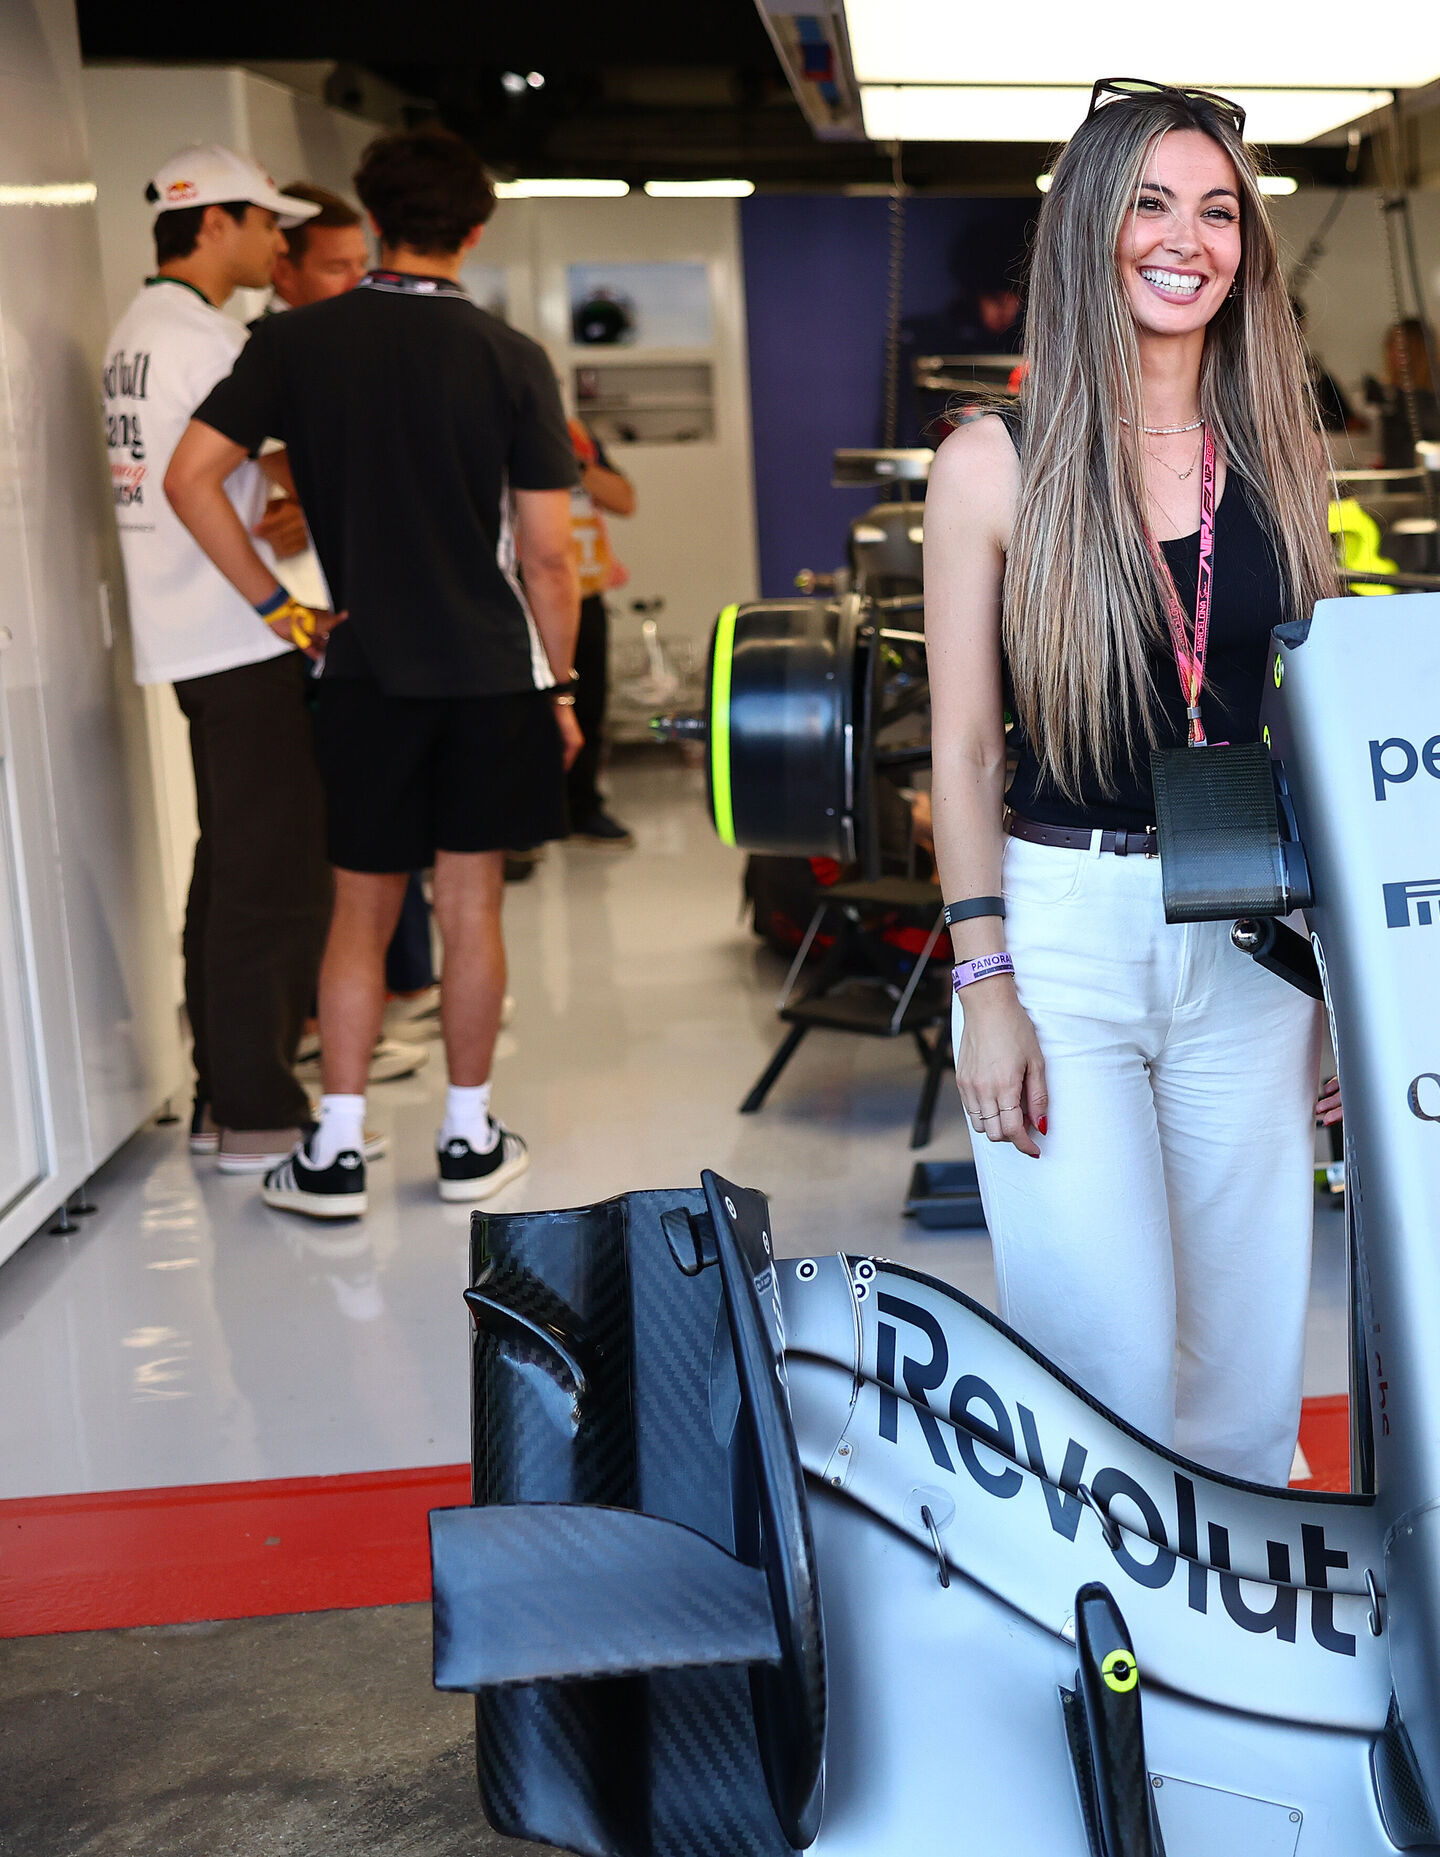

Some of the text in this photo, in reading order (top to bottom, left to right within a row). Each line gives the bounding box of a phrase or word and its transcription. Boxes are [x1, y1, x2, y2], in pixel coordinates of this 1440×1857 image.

[1196, 600, 1207, 652] BARCELONA
[971, 954, 1013, 972] PANORA
[876, 1291, 1357, 1657] Revolut
